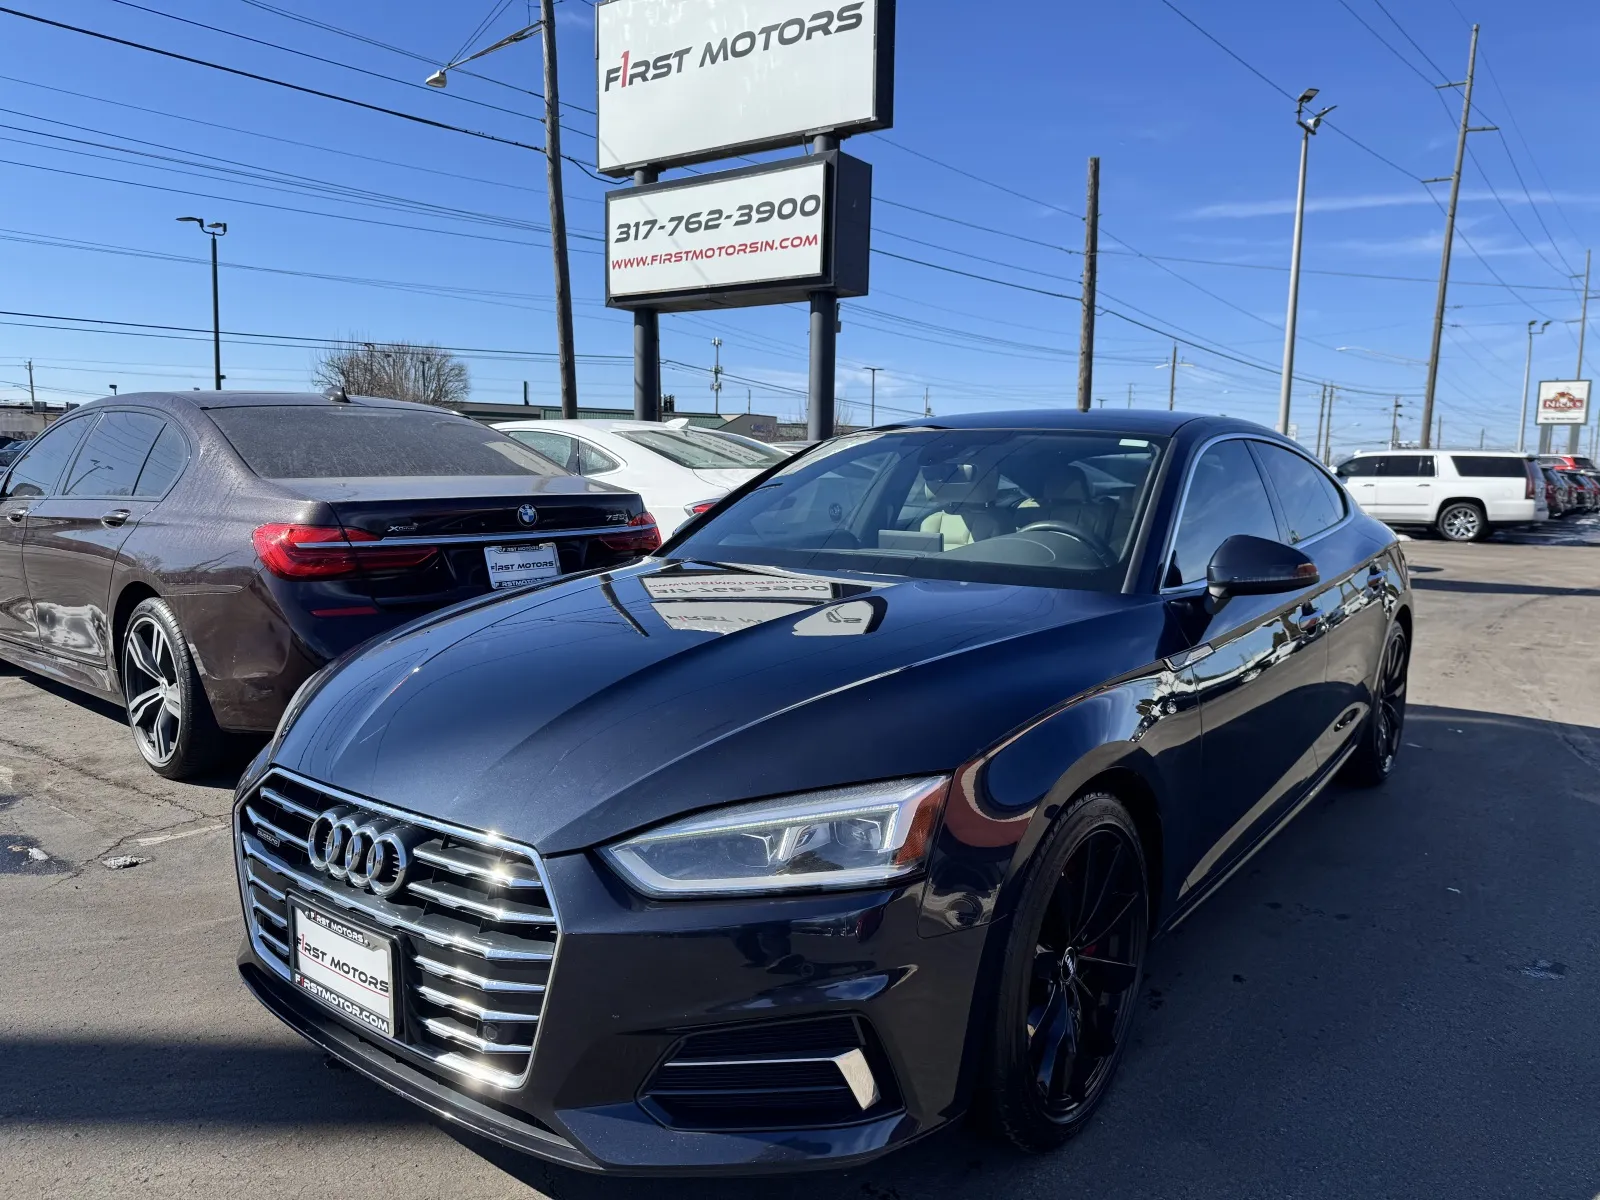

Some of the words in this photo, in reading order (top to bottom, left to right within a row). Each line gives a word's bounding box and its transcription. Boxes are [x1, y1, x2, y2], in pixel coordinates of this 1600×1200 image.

[698, 1, 865, 68] MOTORS
[614, 194, 821, 243] 317-762-3900
[611, 234, 818, 270] WWW.FIRSTMOTORSIN.COM
[517, 560, 554, 570] MOTORS
[330, 921, 364, 943] MOTORS
[329, 957, 389, 993] MOTORS
